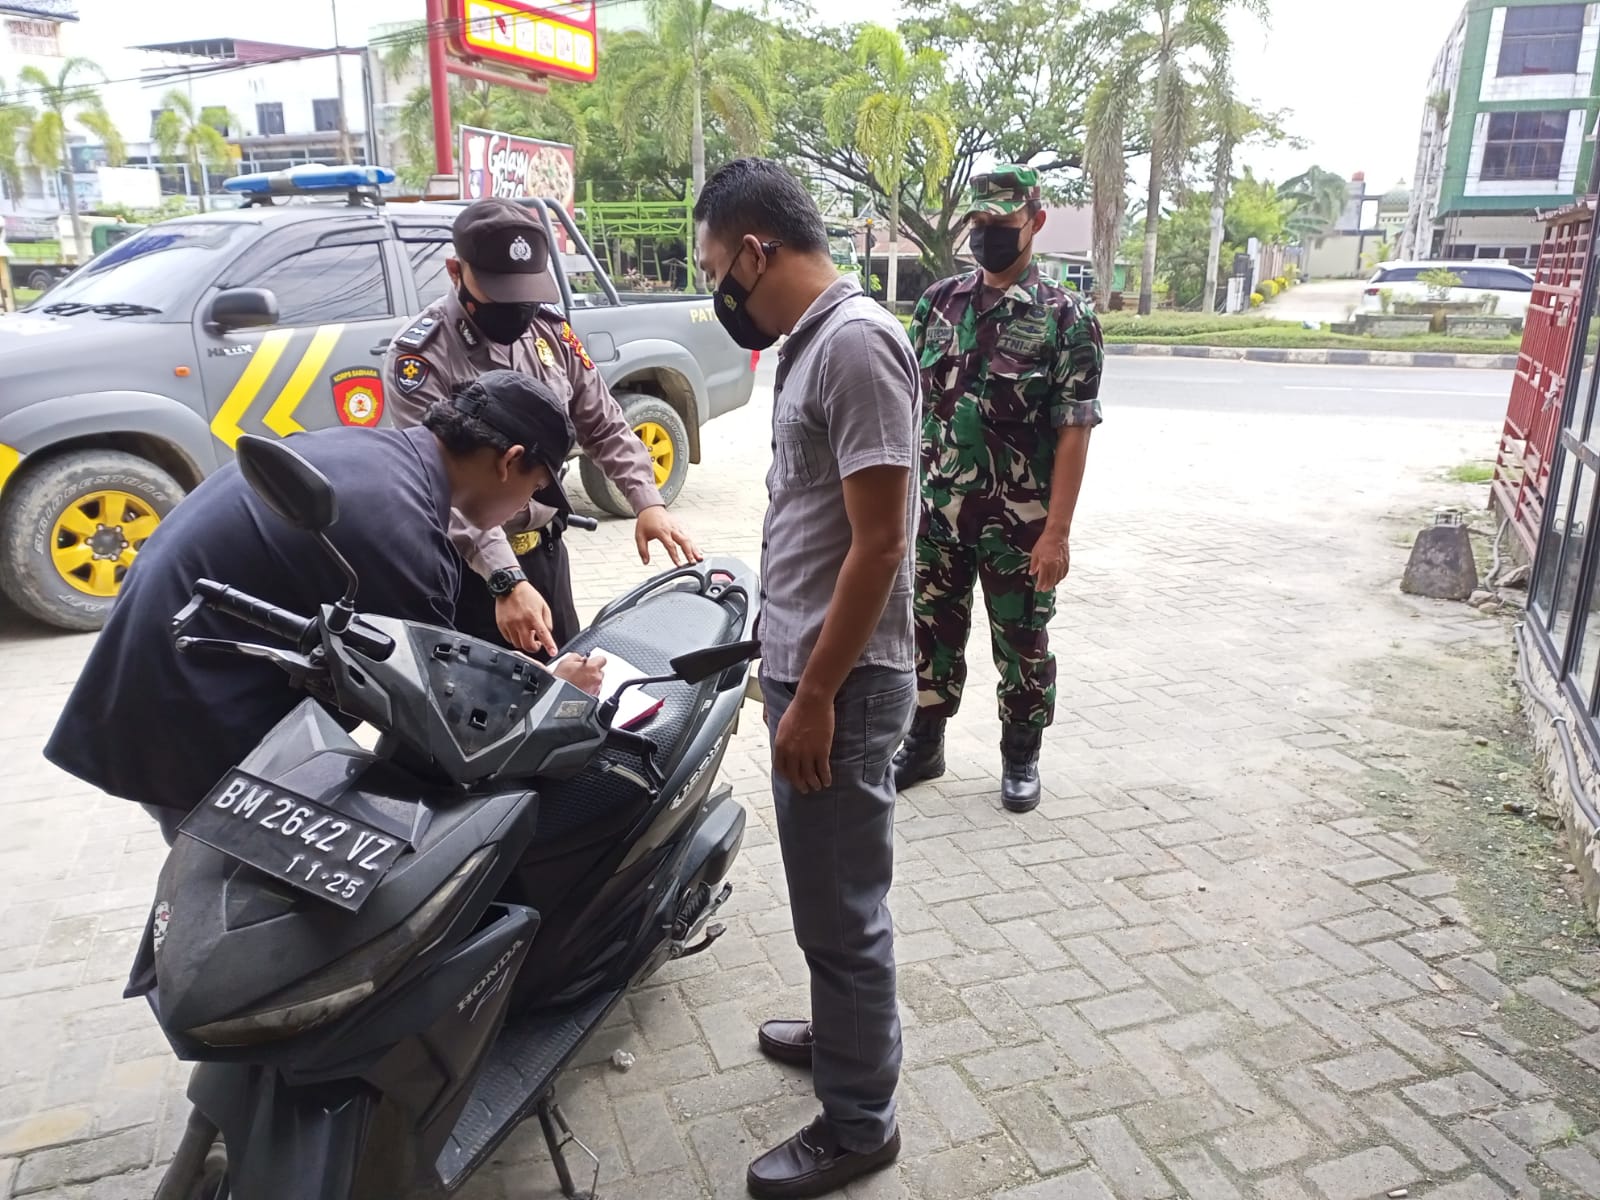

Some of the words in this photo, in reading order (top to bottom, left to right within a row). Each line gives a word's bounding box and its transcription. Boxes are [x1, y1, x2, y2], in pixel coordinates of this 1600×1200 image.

[487, 134, 529, 192] Galaxy
[491, 171, 524, 199] Pizza
[689, 307, 719, 324] PAT
[214, 777, 273, 820] BM
[259, 797, 351, 853] 2642
[346, 830, 397, 872] VZ
[456, 939, 524, 1013] HONDA
